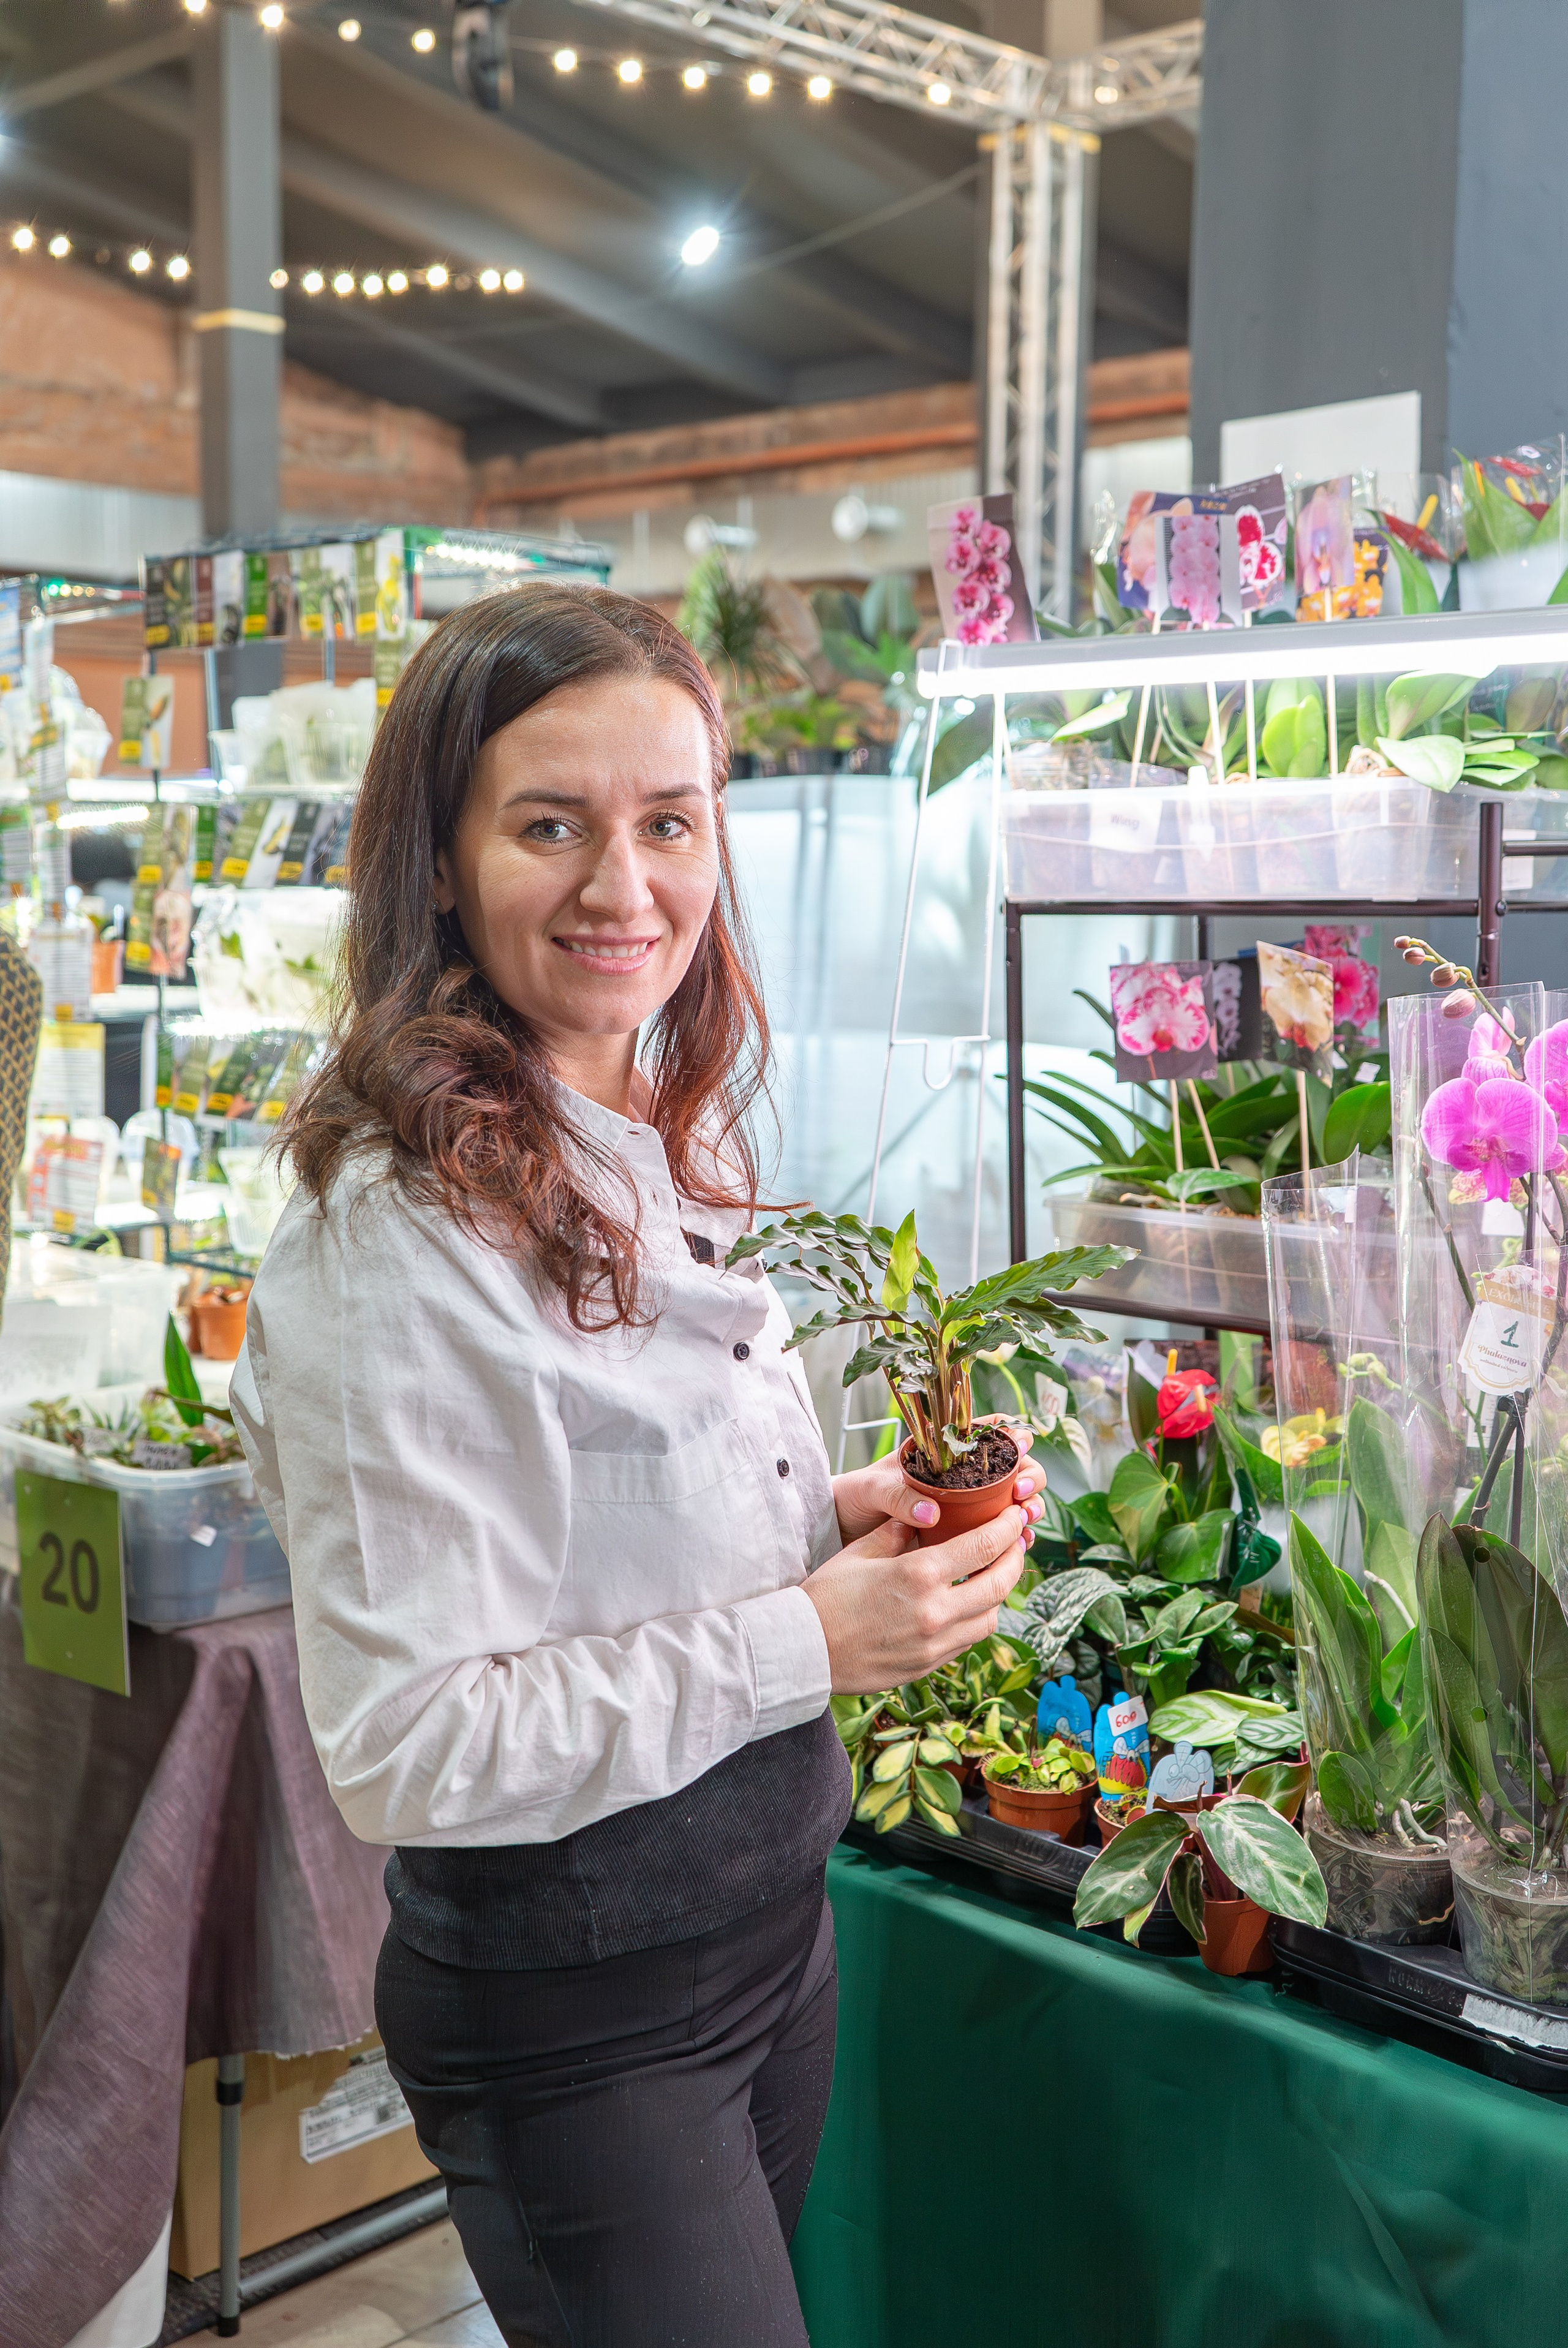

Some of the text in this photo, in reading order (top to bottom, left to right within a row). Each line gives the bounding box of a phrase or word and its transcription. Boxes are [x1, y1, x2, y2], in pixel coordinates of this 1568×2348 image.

[1500, 1321, 1519, 1348] 1
[39, 1531, 100, 1614] 20
[1115, 1711, 1137, 1727] 600
